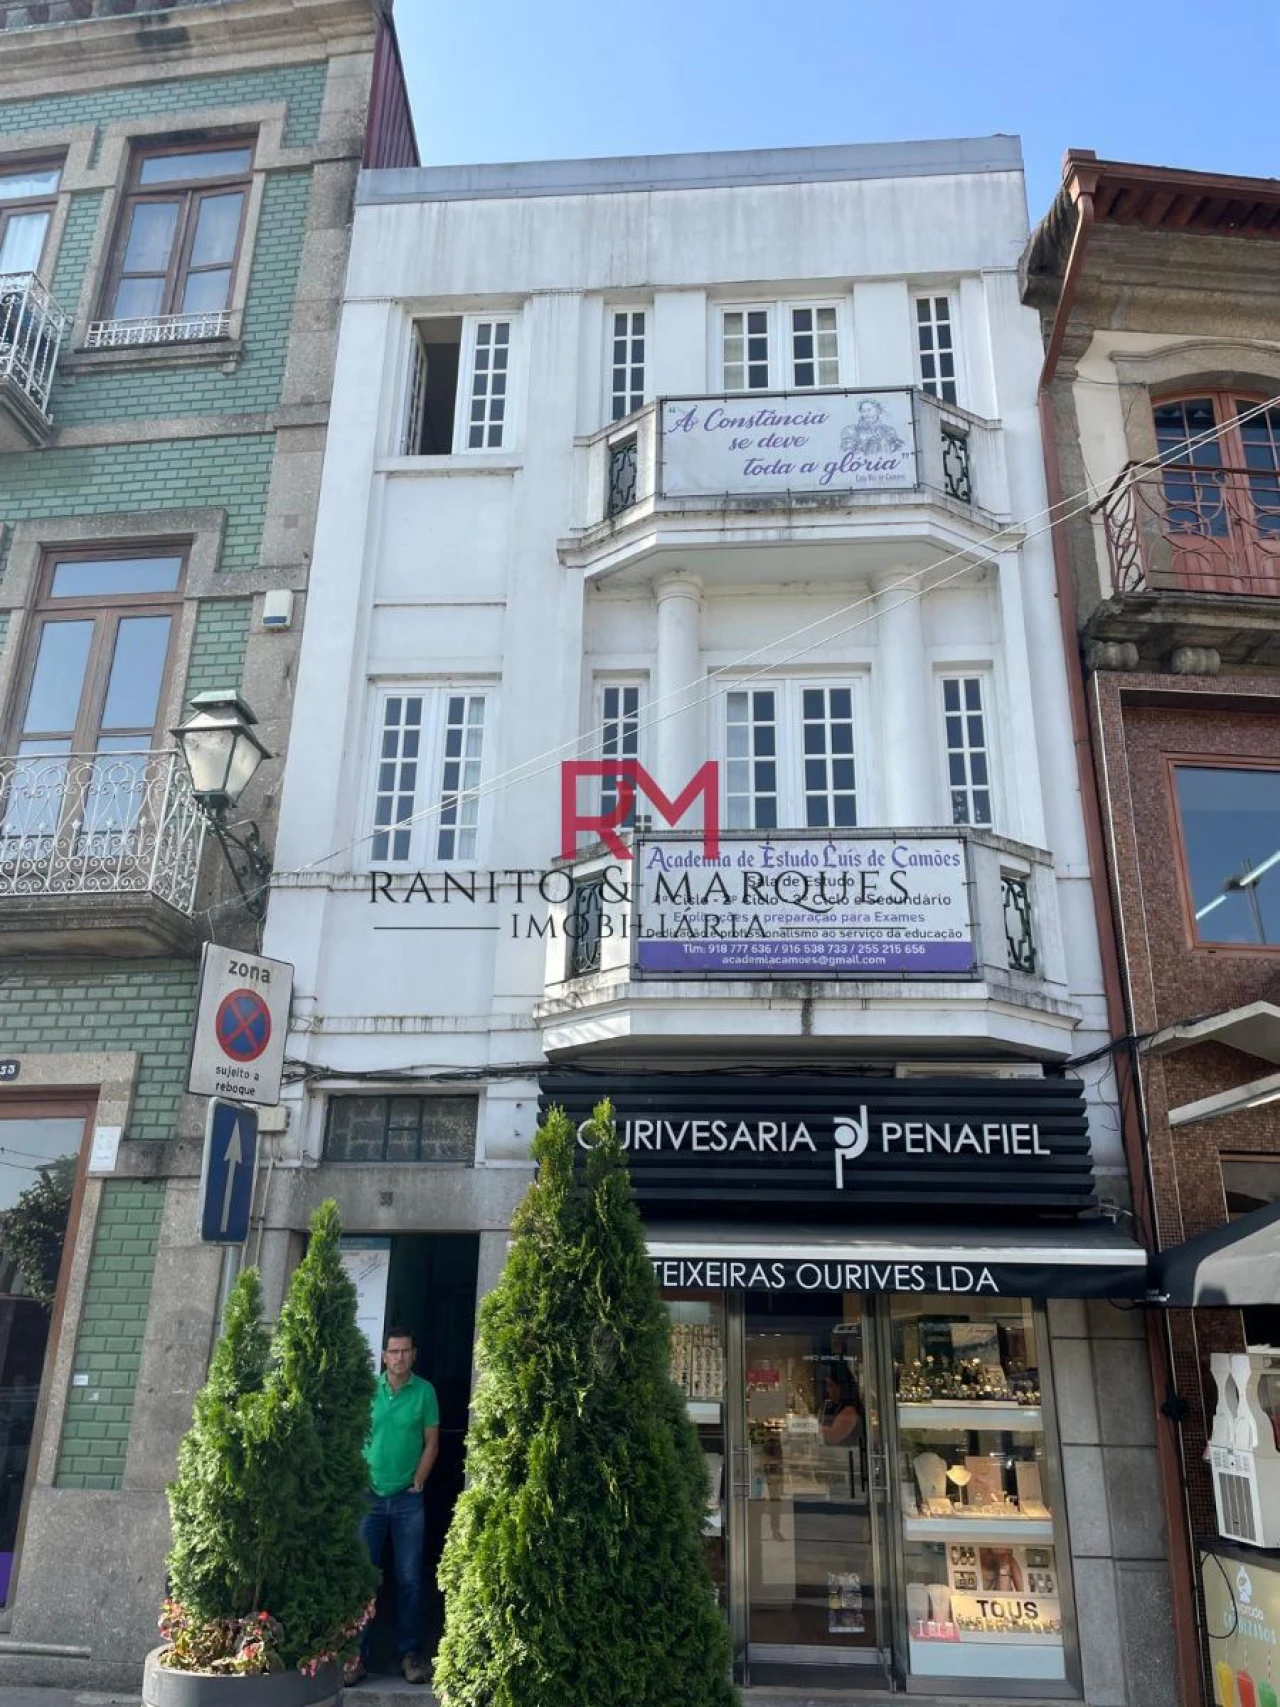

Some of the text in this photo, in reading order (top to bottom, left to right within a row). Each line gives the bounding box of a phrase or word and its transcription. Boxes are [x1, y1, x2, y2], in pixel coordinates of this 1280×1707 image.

[703, 406, 829, 432] Constância
[728, 432, 809, 452] se deve
[743, 457, 796, 476] toda
[800, 461, 819, 474] a
[646, 844, 961, 872] Academia de Estudo Luís de Camões
[747, 875, 855, 887] Sala de Estudo
[764, 912, 837, 924] preparação
[841, 914, 871, 924] para
[875, 911, 926, 923] Exames
[839, 929, 883, 941] serviço
[886, 929, 901, 938] da
[905, 928, 962, 941] educação
[708, 944, 728, 954] 918
[731, 944, 748, 954] 777
[773, 944, 780, 954] /
[849, 944, 855, 954] /
[858, 944, 880, 954] 255
[722, 954, 886, 966] academiacamoes@gmail.com
[228, 960, 270, 983] zona
[216, 1066, 260, 1081] sujeito a
[216, 1082, 256, 1096] reboque
[577, 1118, 1051, 1155] OURIVESARIA PENAFIEL
[652, 1261, 999, 1292] TEIXEIRAS OURIVES LDA
[976, 1599, 1039, 1620] TOUS
